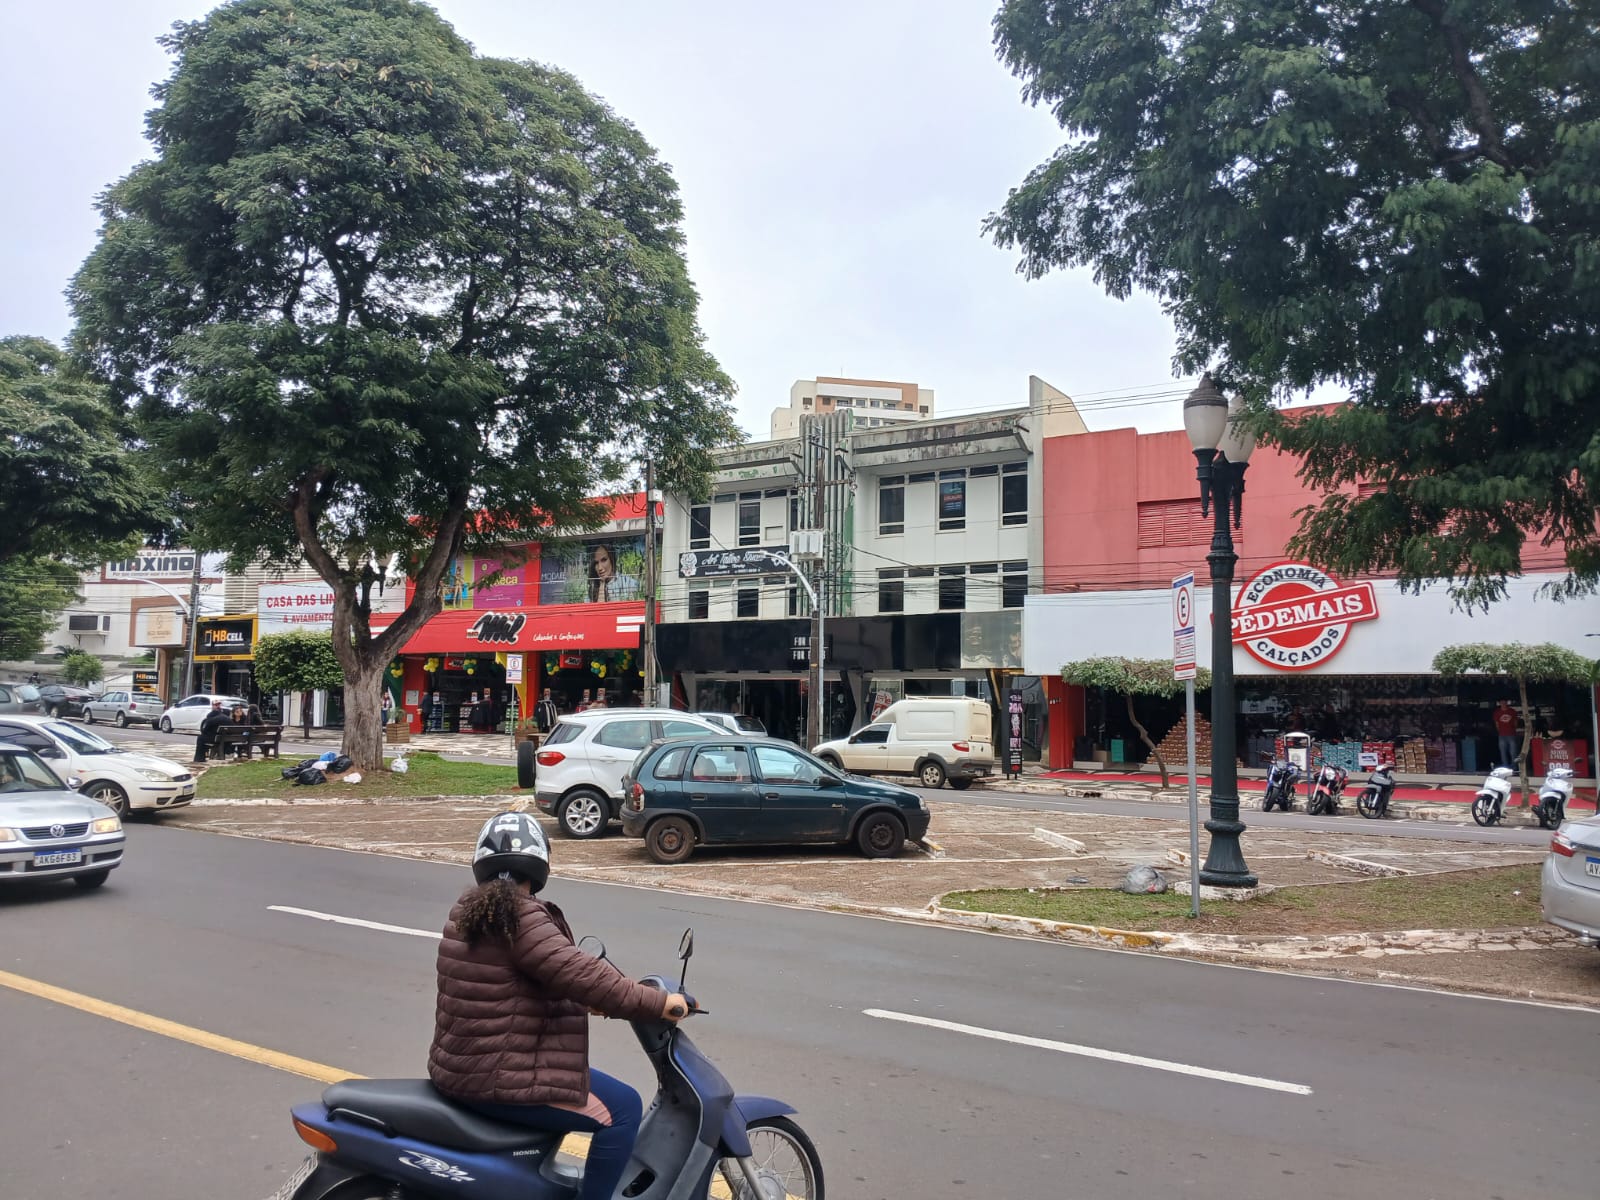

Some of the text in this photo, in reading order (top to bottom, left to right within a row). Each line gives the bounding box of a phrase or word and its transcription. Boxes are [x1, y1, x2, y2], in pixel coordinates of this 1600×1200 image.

[1247, 567, 1326, 603] ECONOMIA
[266, 595, 293, 608] CASA
[296, 594, 316, 606] DAS
[1257, 628, 1339, 665] CALÇADOS
[513, 1149, 541, 1157] HONDA
